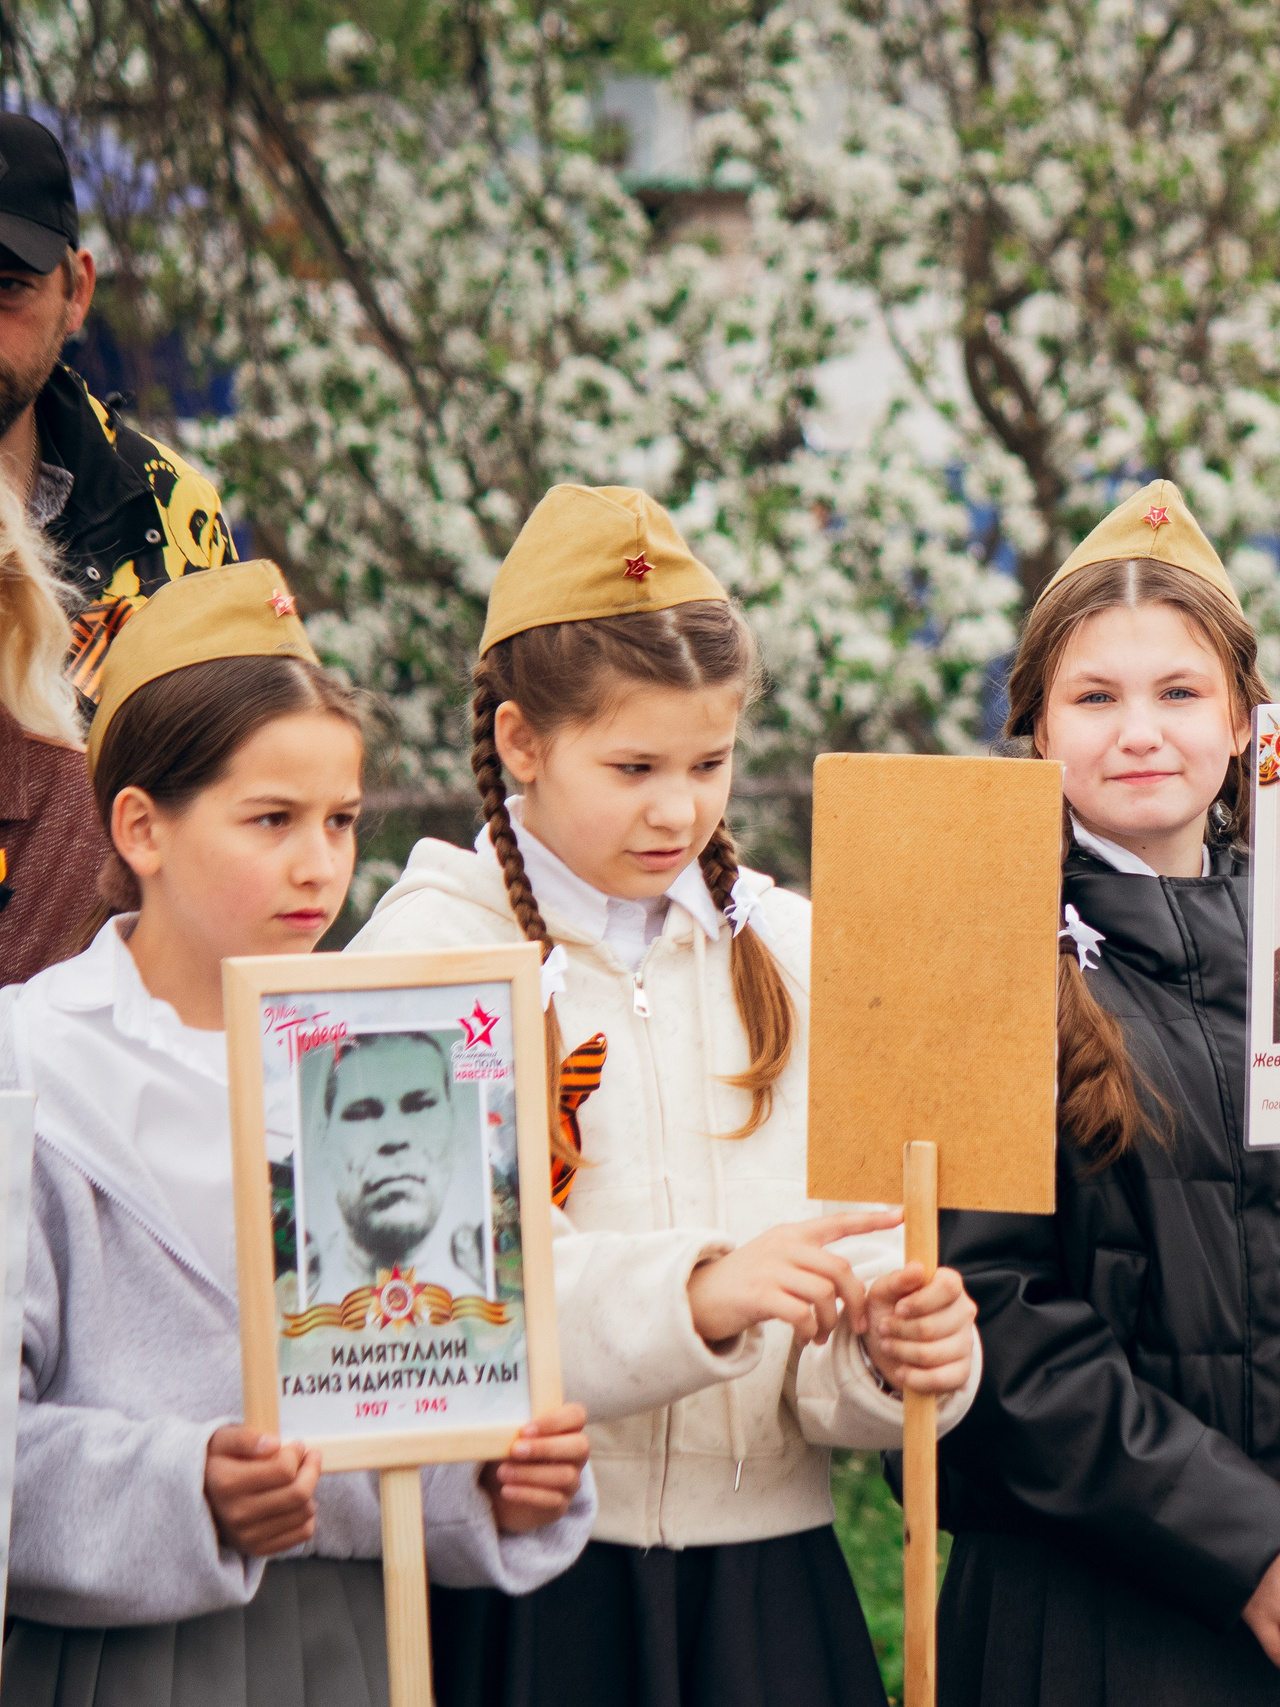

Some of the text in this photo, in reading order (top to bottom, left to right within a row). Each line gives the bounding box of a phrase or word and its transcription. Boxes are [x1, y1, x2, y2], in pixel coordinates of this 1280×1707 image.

[331, 1338, 468, 1367] ИДИЯТУЛЛИН
[281, 1362, 519, 1396] ГАЗИЗ ИДИЯТУЛЛА УЛЫ
[355, 1400, 388, 1418] 1907
